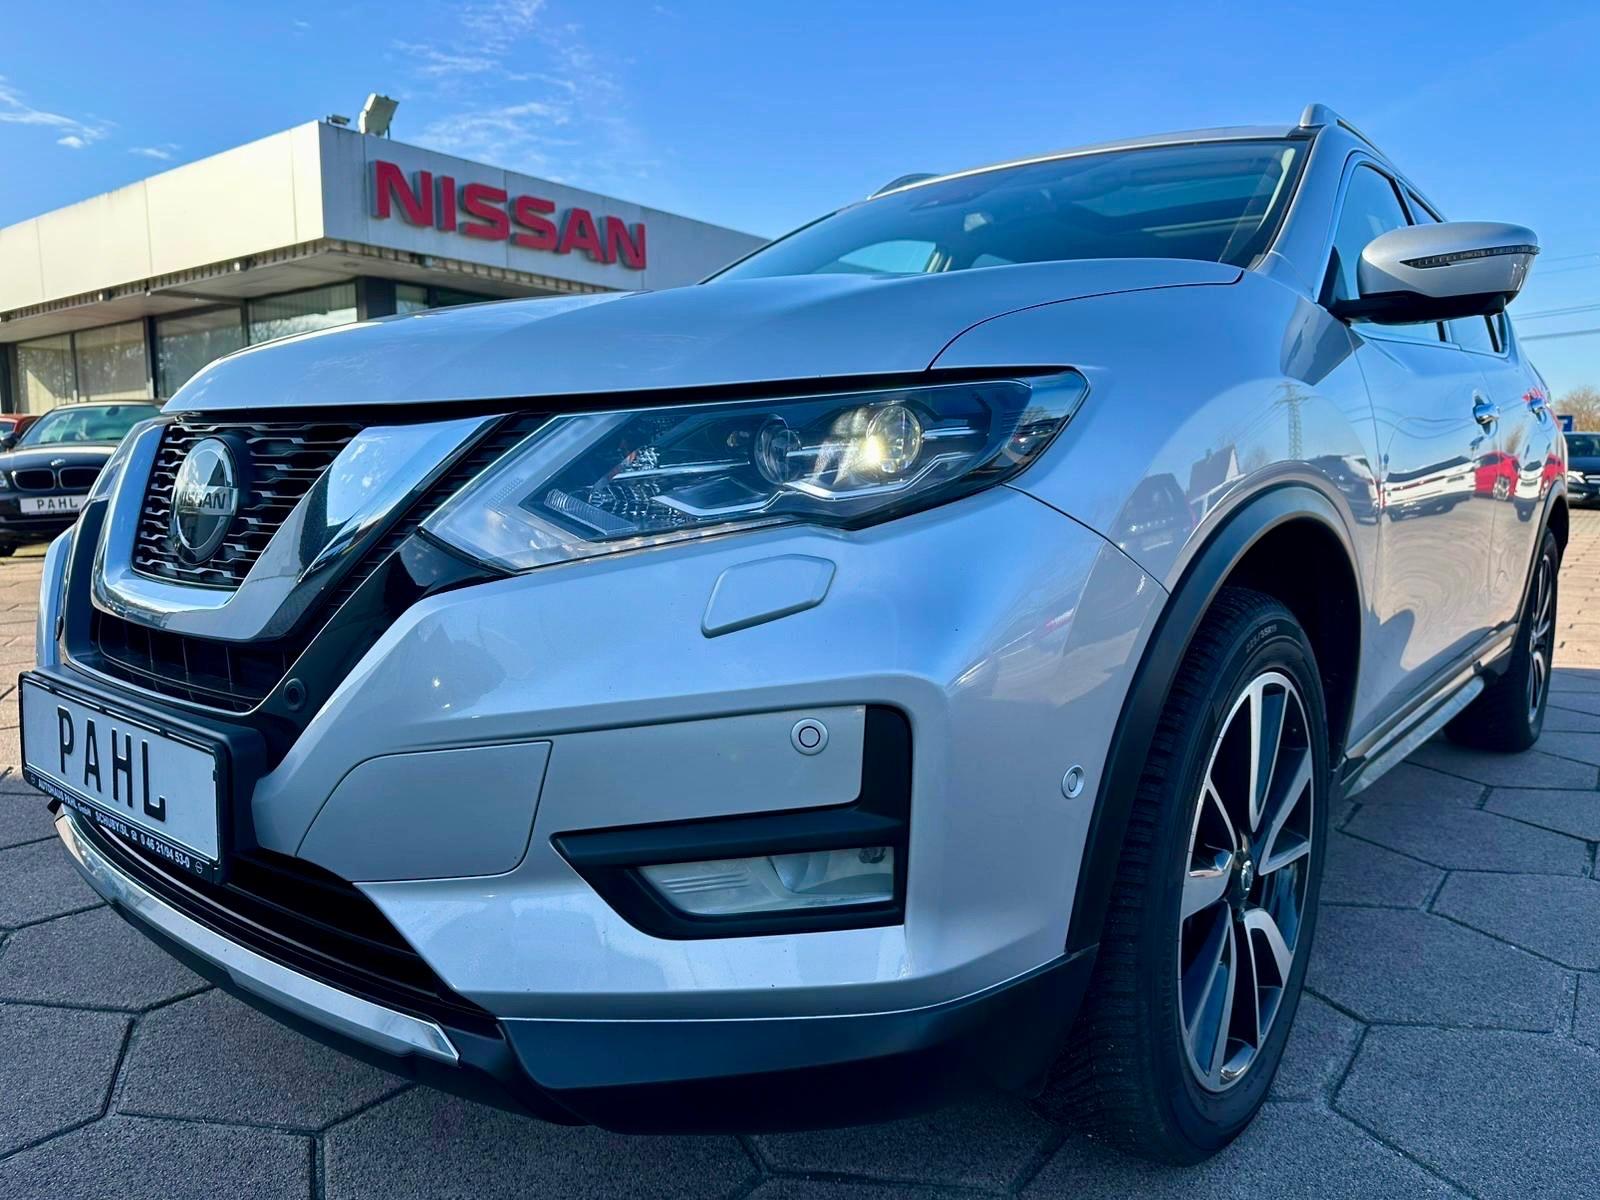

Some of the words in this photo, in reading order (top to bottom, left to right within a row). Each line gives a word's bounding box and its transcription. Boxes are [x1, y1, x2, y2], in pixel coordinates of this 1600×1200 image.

[370, 159, 647, 271] NISSAN
[36, 497, 79, 510] PAHL
[178, 491, 226, 510] NISSAN
[57, 705, 166, 823] PAHL
[174, 851, 190, 868] 53-0
